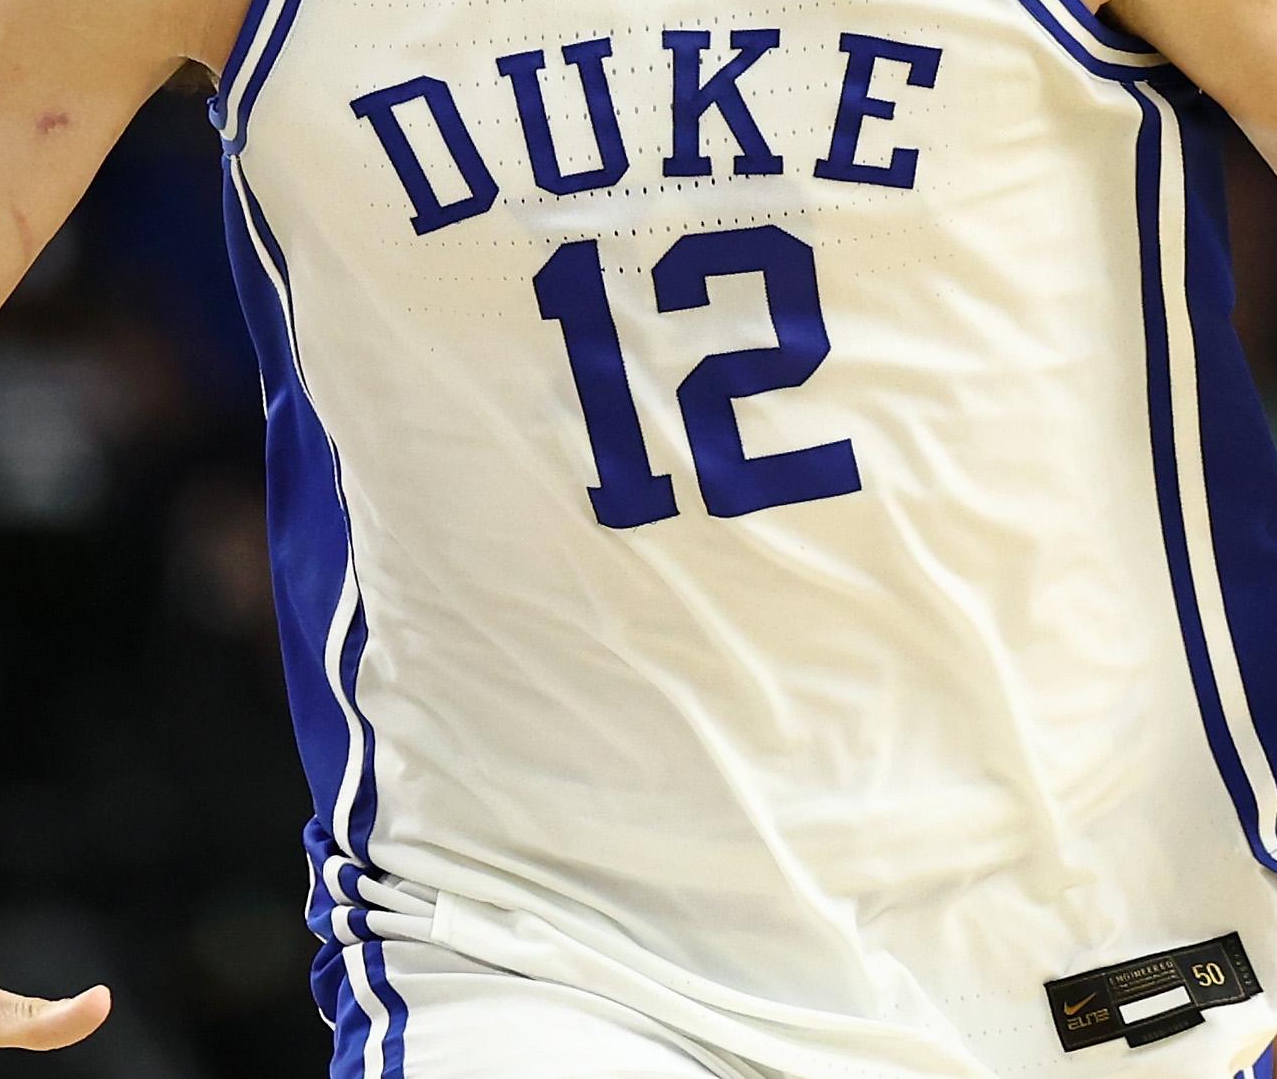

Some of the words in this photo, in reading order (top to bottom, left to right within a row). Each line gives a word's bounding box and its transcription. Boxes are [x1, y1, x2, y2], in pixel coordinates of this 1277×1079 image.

[349, 28, 943, 236] DUKE
[532, 224, 862, 529] 12
[1067, 1008, 1111, 1031] ELITE
[1191, 962, 1226, 987] 50
